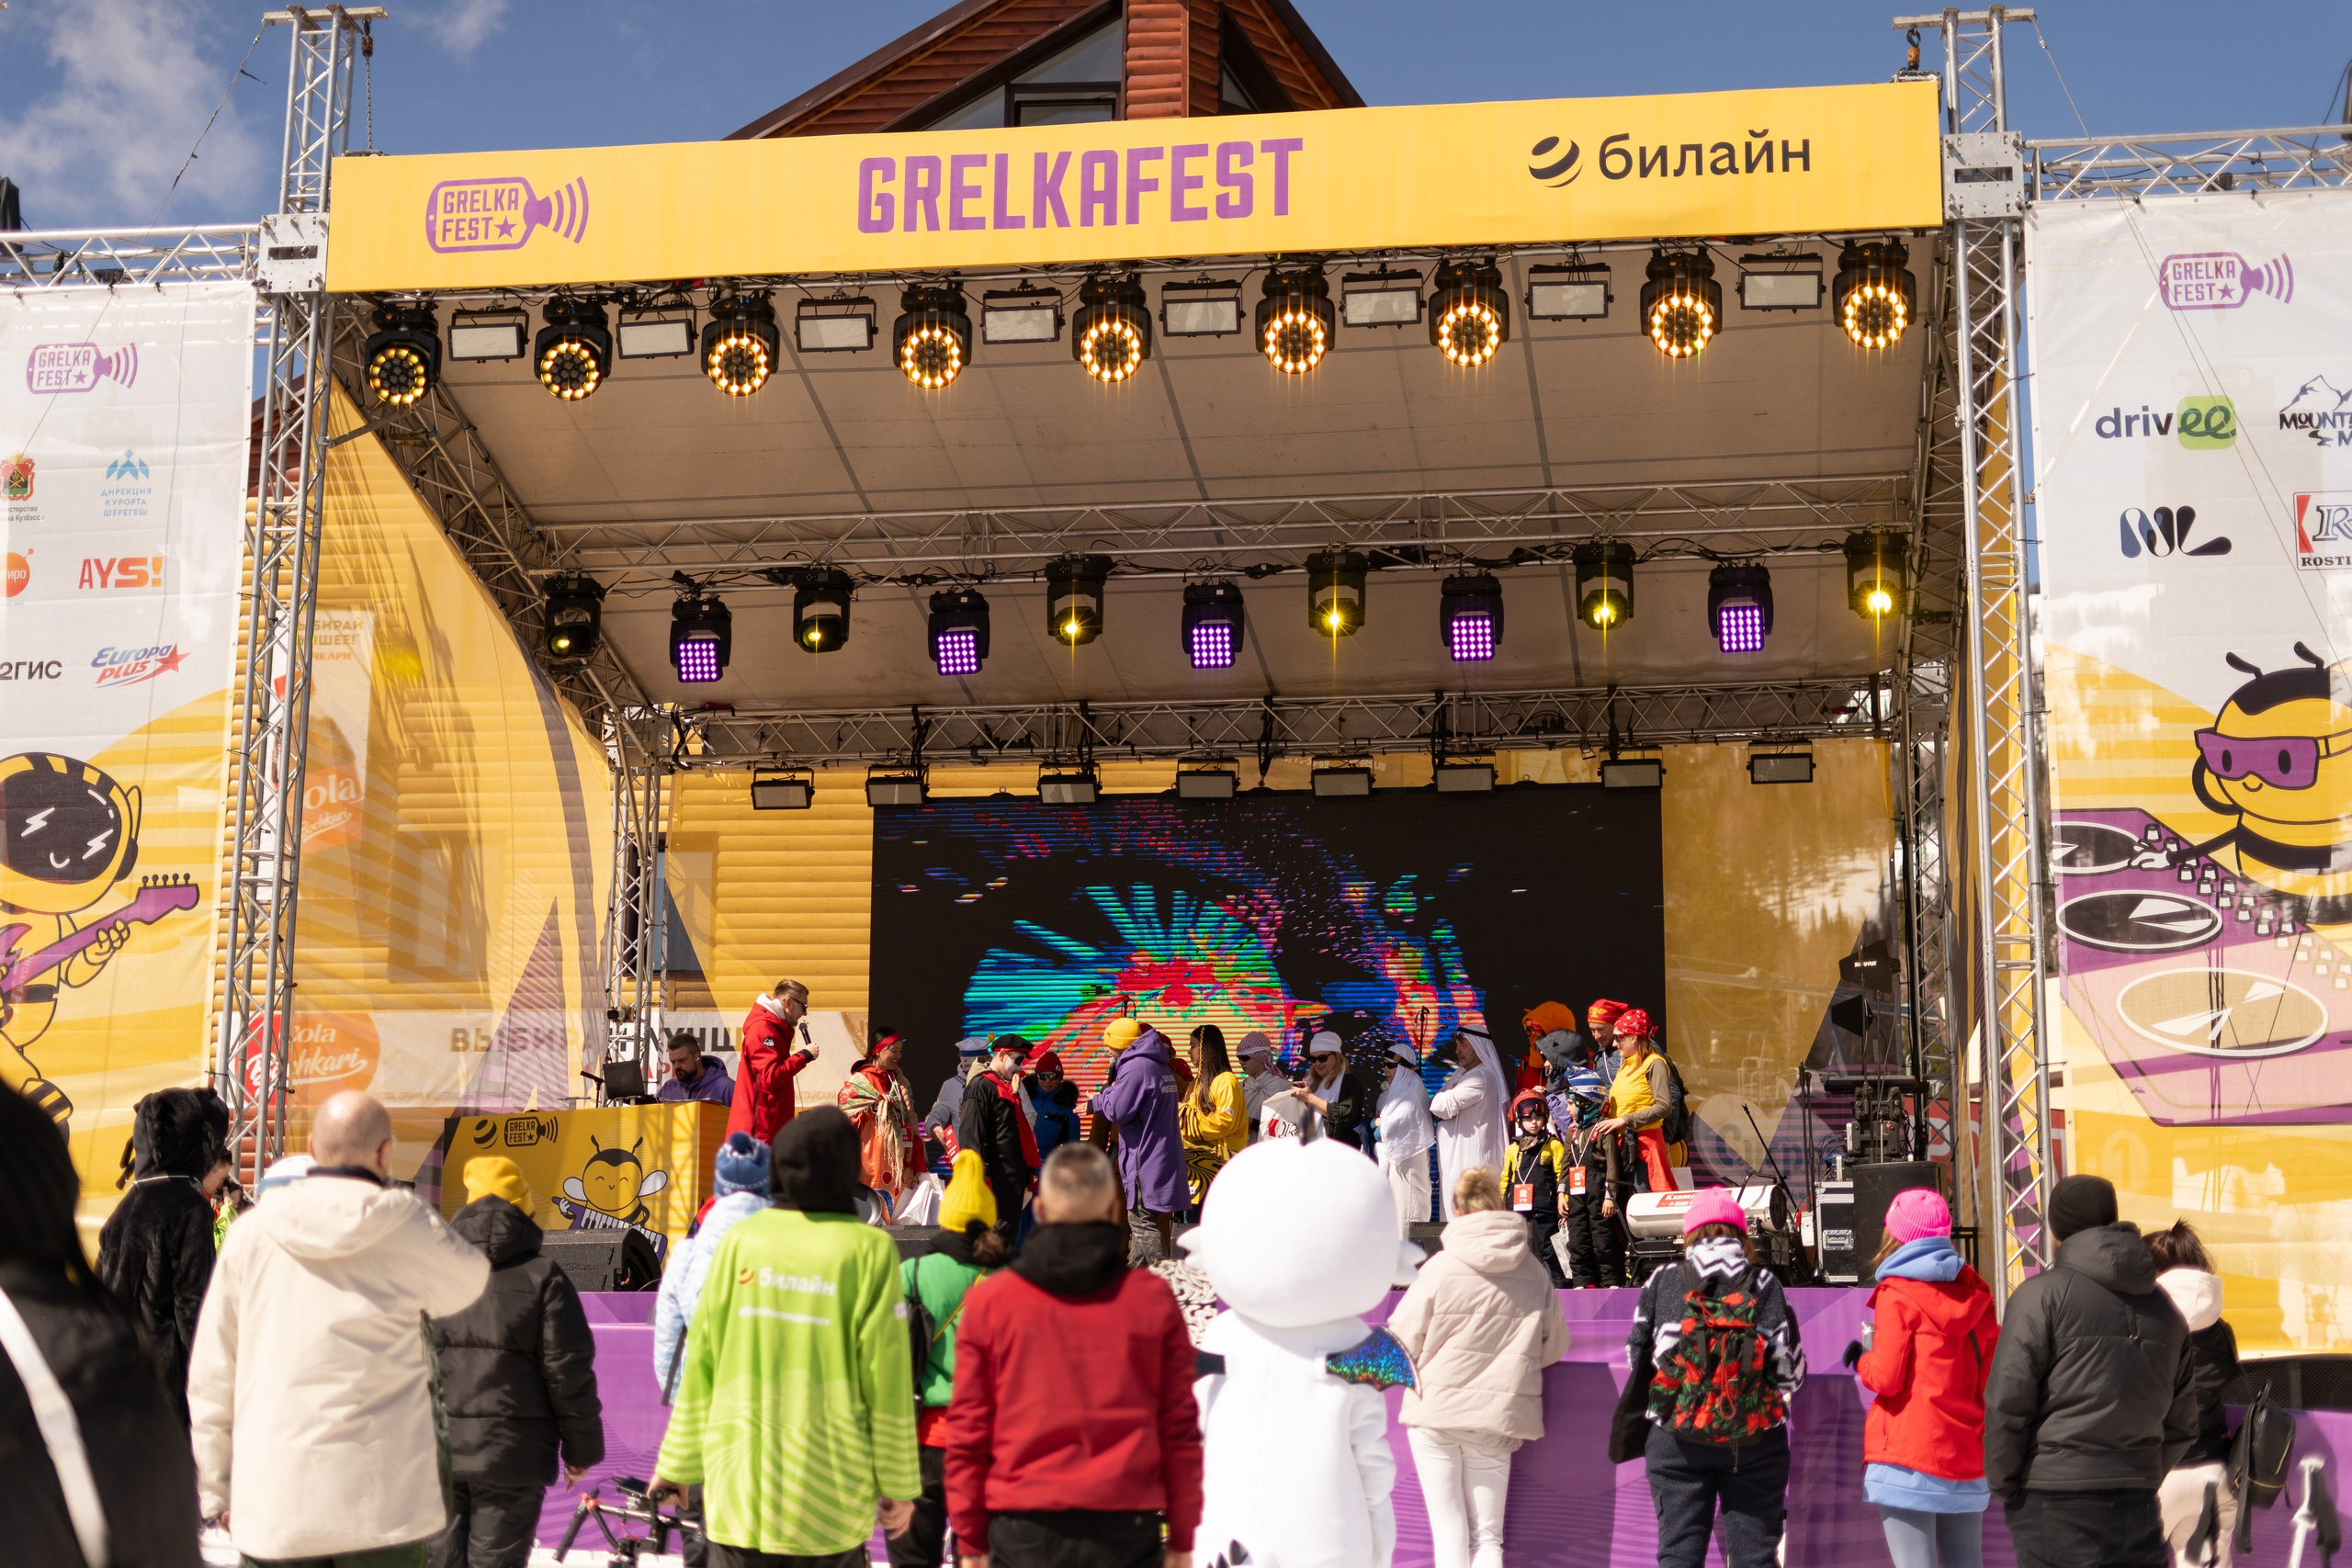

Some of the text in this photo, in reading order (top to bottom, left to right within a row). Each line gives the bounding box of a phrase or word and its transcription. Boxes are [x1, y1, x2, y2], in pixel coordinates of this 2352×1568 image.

[1599, 129, 1811, 180] билайн
[857, 137, 1304, 234] GRELKAFEST
[443, 186, 520, 215] GRELKA
[442, 216, 494, 243] FEST
[2172, 260, 2237, 281] GRELKA
[2174, 283, 2218, 302] FEST
[38, 348, 91, 368] GRELKA
[37, 368, 73, 387] FEST
[2095, 405, 2237, 440] drivee
[2279, 412, 2352, 431] MOUNT
[100, 488, 153, 497] ДИРЕКЦИЯ
[103, 508, 148, 517] ШЕРЕГЕШ
[78, 556, 164, 590] AYS!
[0, 660, 62, 681] 2ГИС
[288, 773, 358, 810] ola
[450, 1027, 628, 1052] ВЫБИР
[509, 1121, 536, 1132] GRELKA
[509, 1132, 527, 1143] FEST
[759, 1267, 836, 1296] билайн
